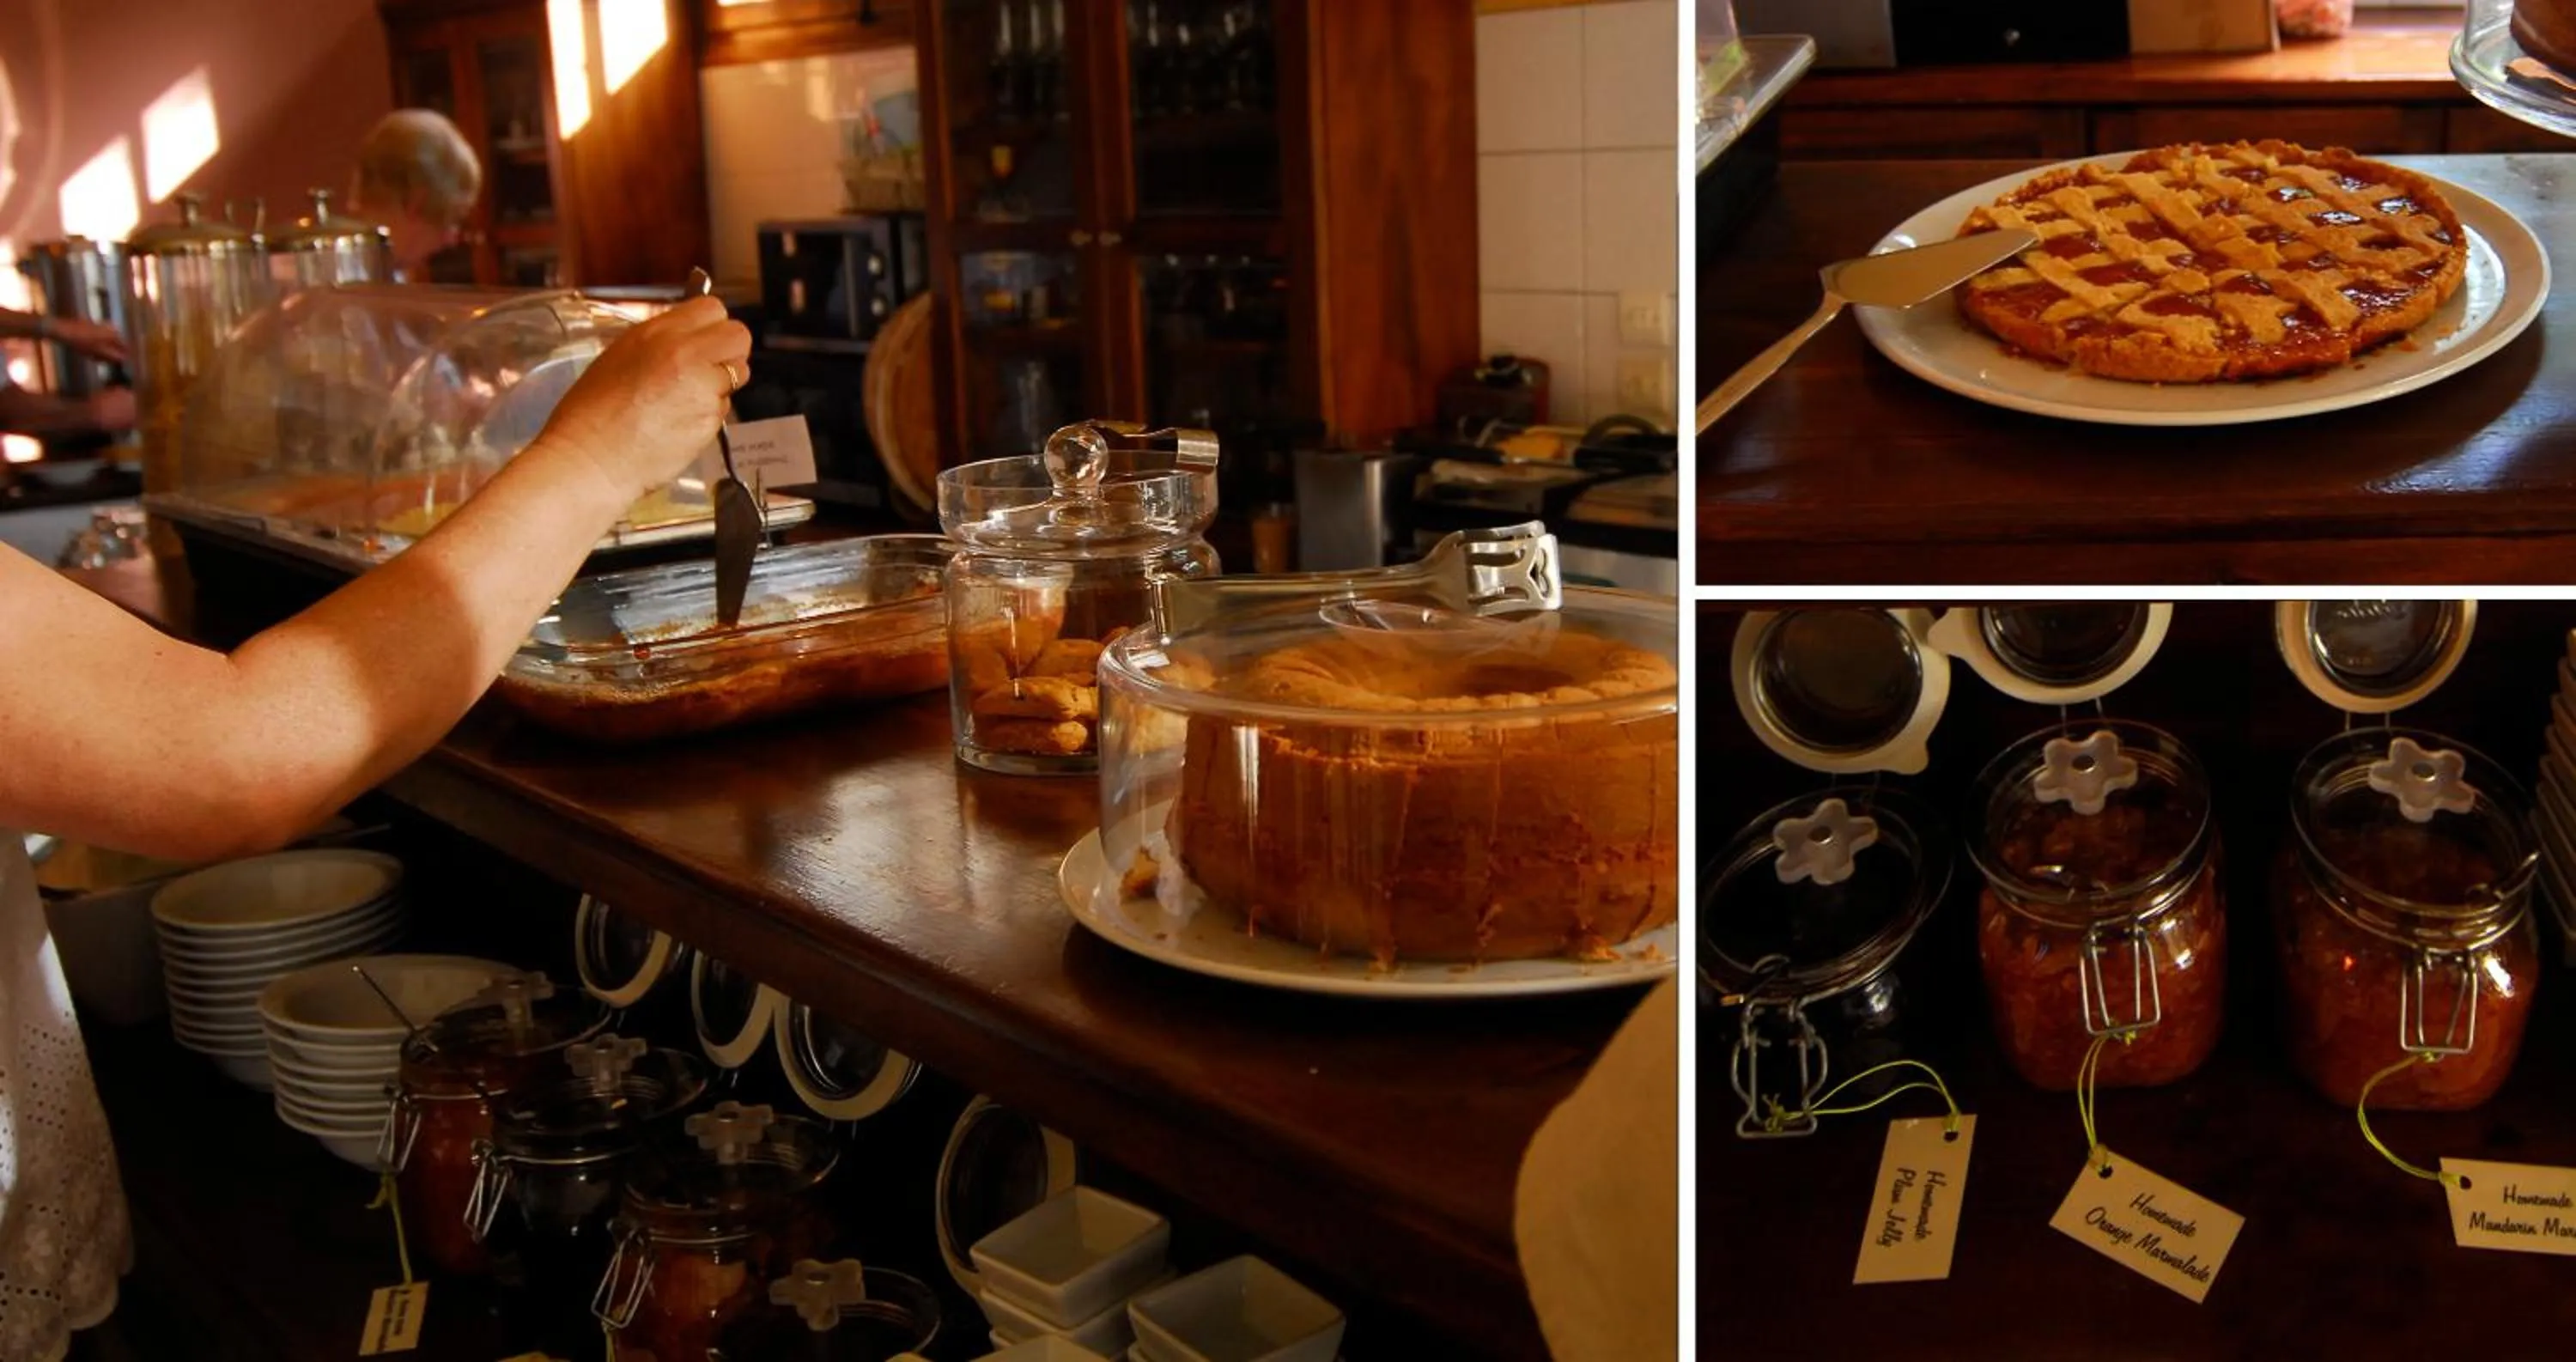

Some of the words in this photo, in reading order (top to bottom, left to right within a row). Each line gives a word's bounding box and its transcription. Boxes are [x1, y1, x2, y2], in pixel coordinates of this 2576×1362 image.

[1915, 1170, 1947, 1239] Homemade
[2129, 1193, 2196, 1237] Homemade
[2503, 1184, 2573, 1208] Homemade
[1876, 1209, 1906, 1247] Jelly
[2086, 1207, 2132, 1244] Orange
[2135, 1233, 2210, 1283] Marmalade
[2469, 1211, 2537, 1235] Mandarin
[2543, 1217, 2576, 1239] Mar
